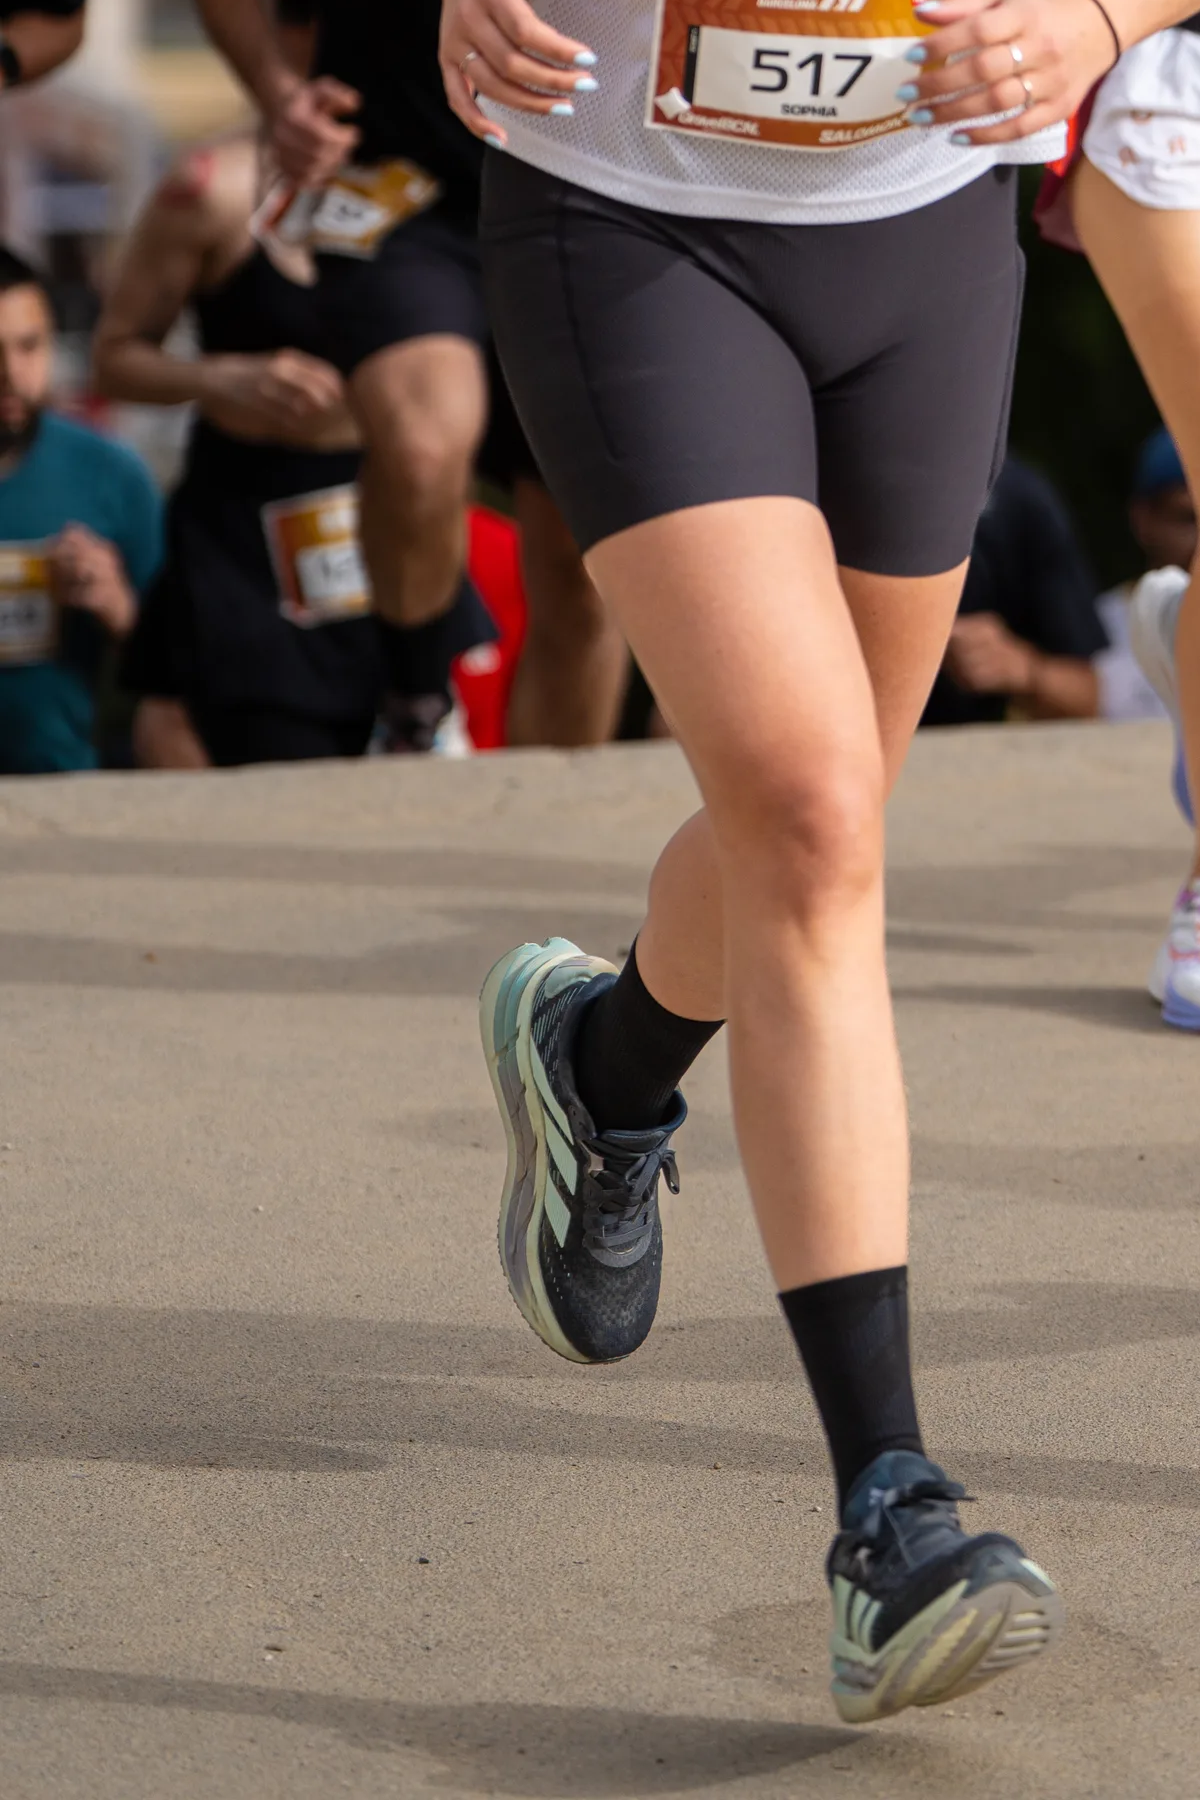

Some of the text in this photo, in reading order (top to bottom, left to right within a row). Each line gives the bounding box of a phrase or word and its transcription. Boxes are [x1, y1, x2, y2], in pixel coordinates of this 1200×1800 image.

[750, 49, 872, 98] 517
[781, 104, 838, 117] SOPHIA
[819, 117, 904, 143] SALOMON
